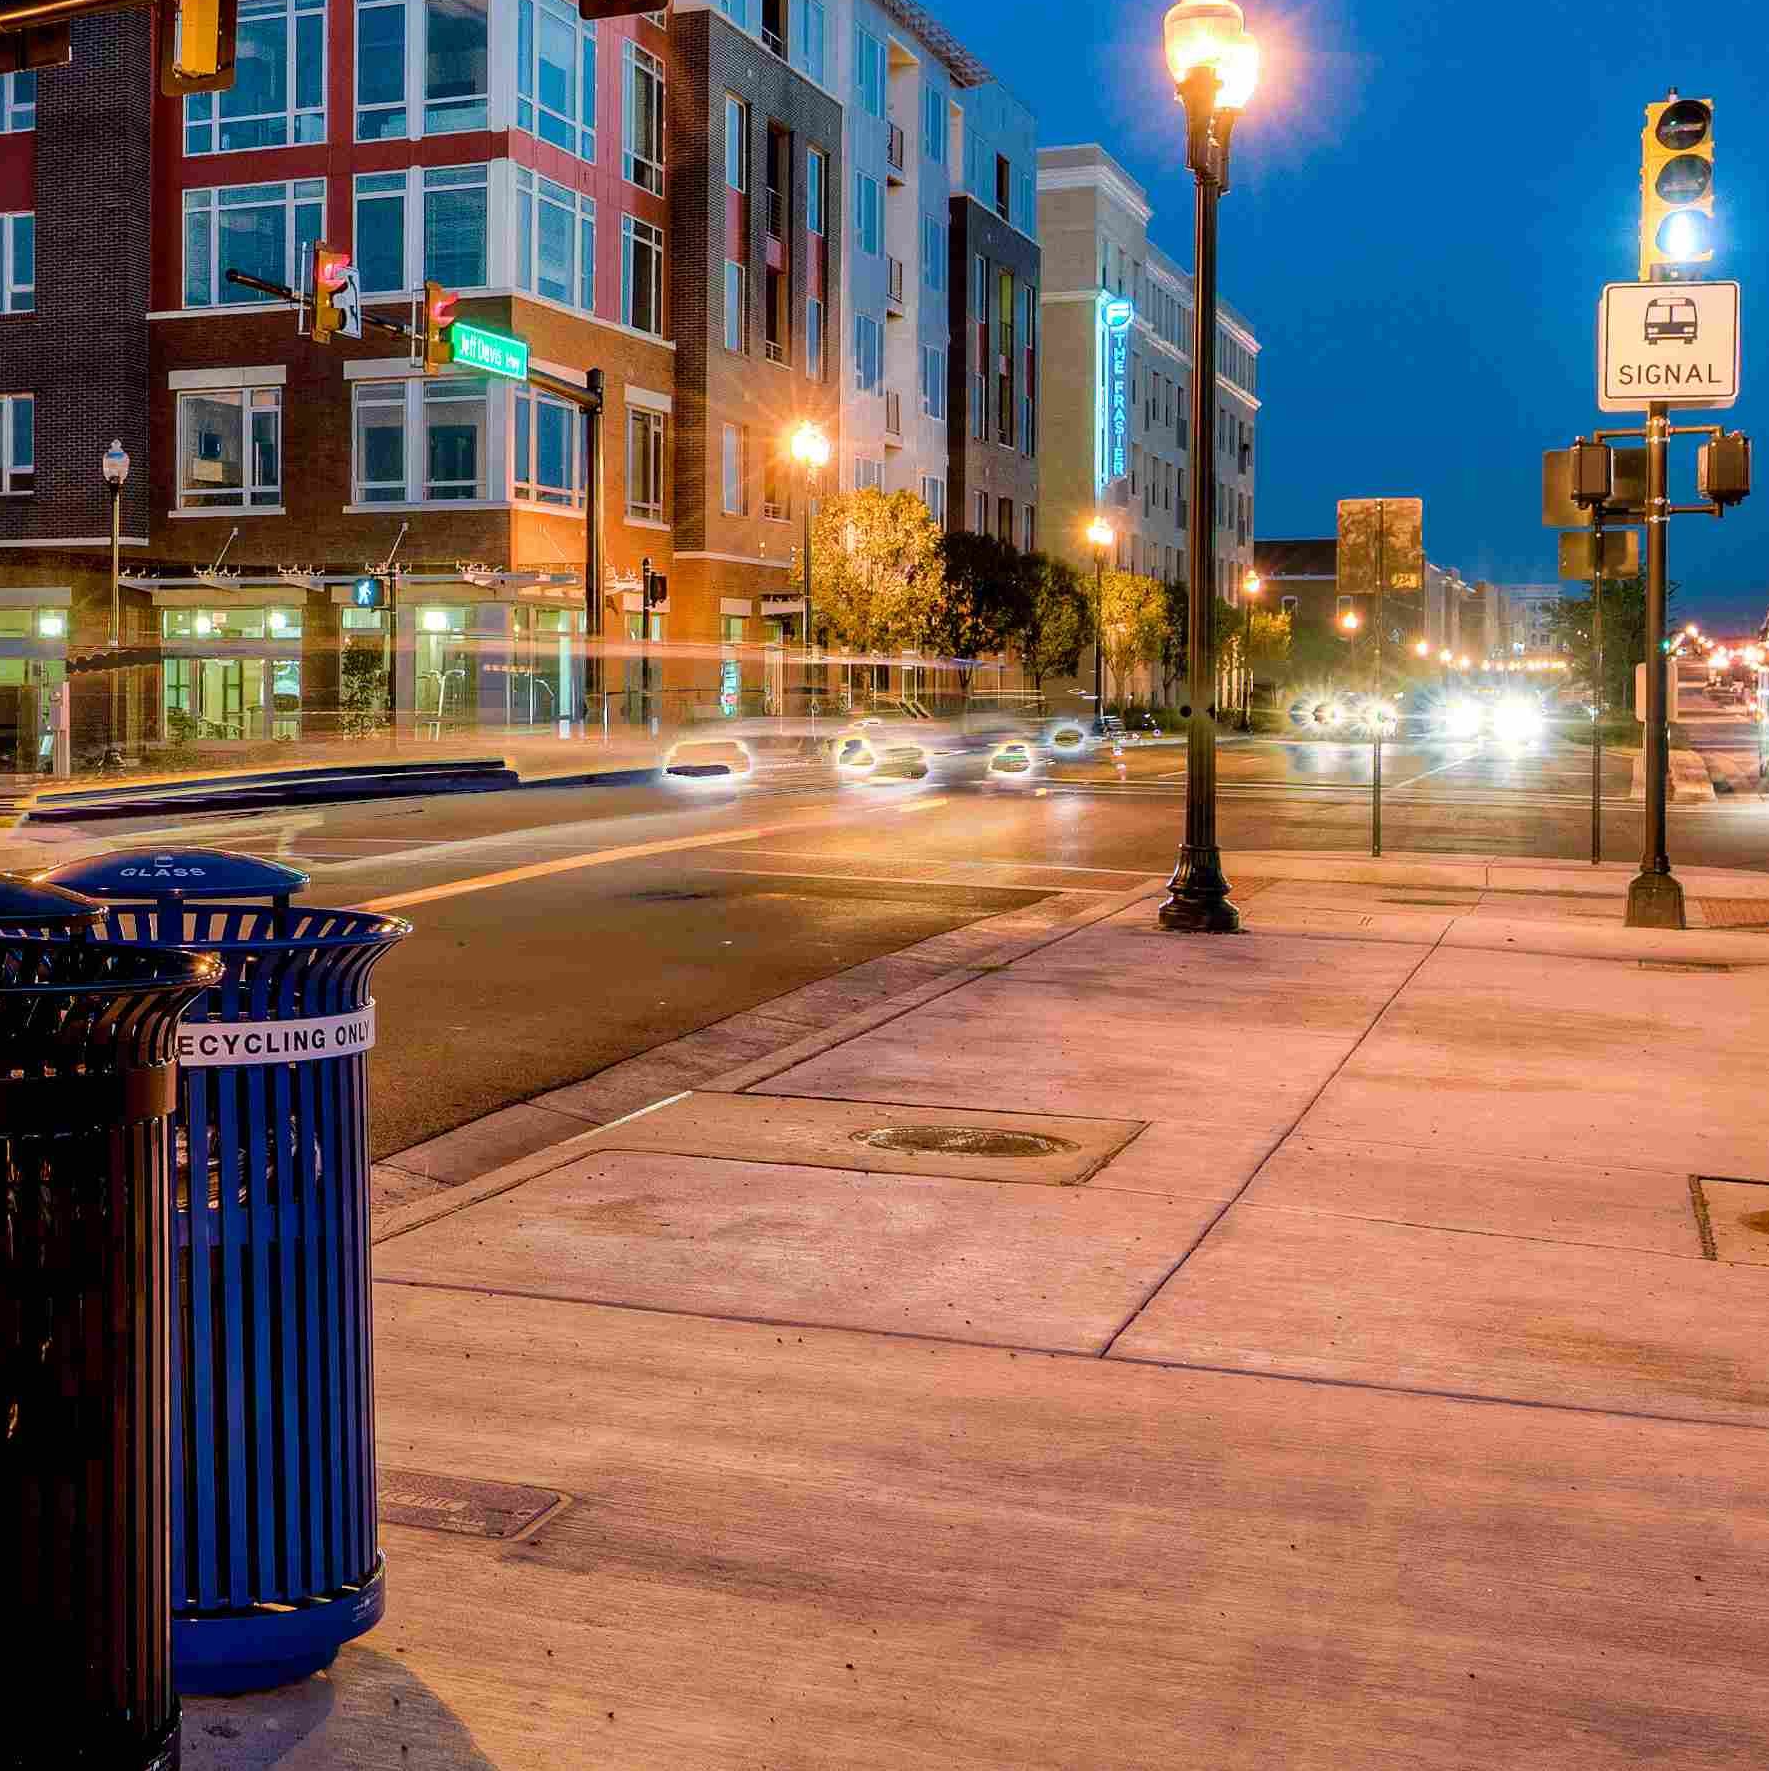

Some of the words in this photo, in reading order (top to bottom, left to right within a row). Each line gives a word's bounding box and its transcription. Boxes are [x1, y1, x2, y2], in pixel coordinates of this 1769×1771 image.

[1618, 363, 1723, 386] SIGNAL
[119, 867, 207, 877] GLASS
[177, 1028, 326, 1056] ECYCLING
[335, 1019, 370, 1047] ONLY
